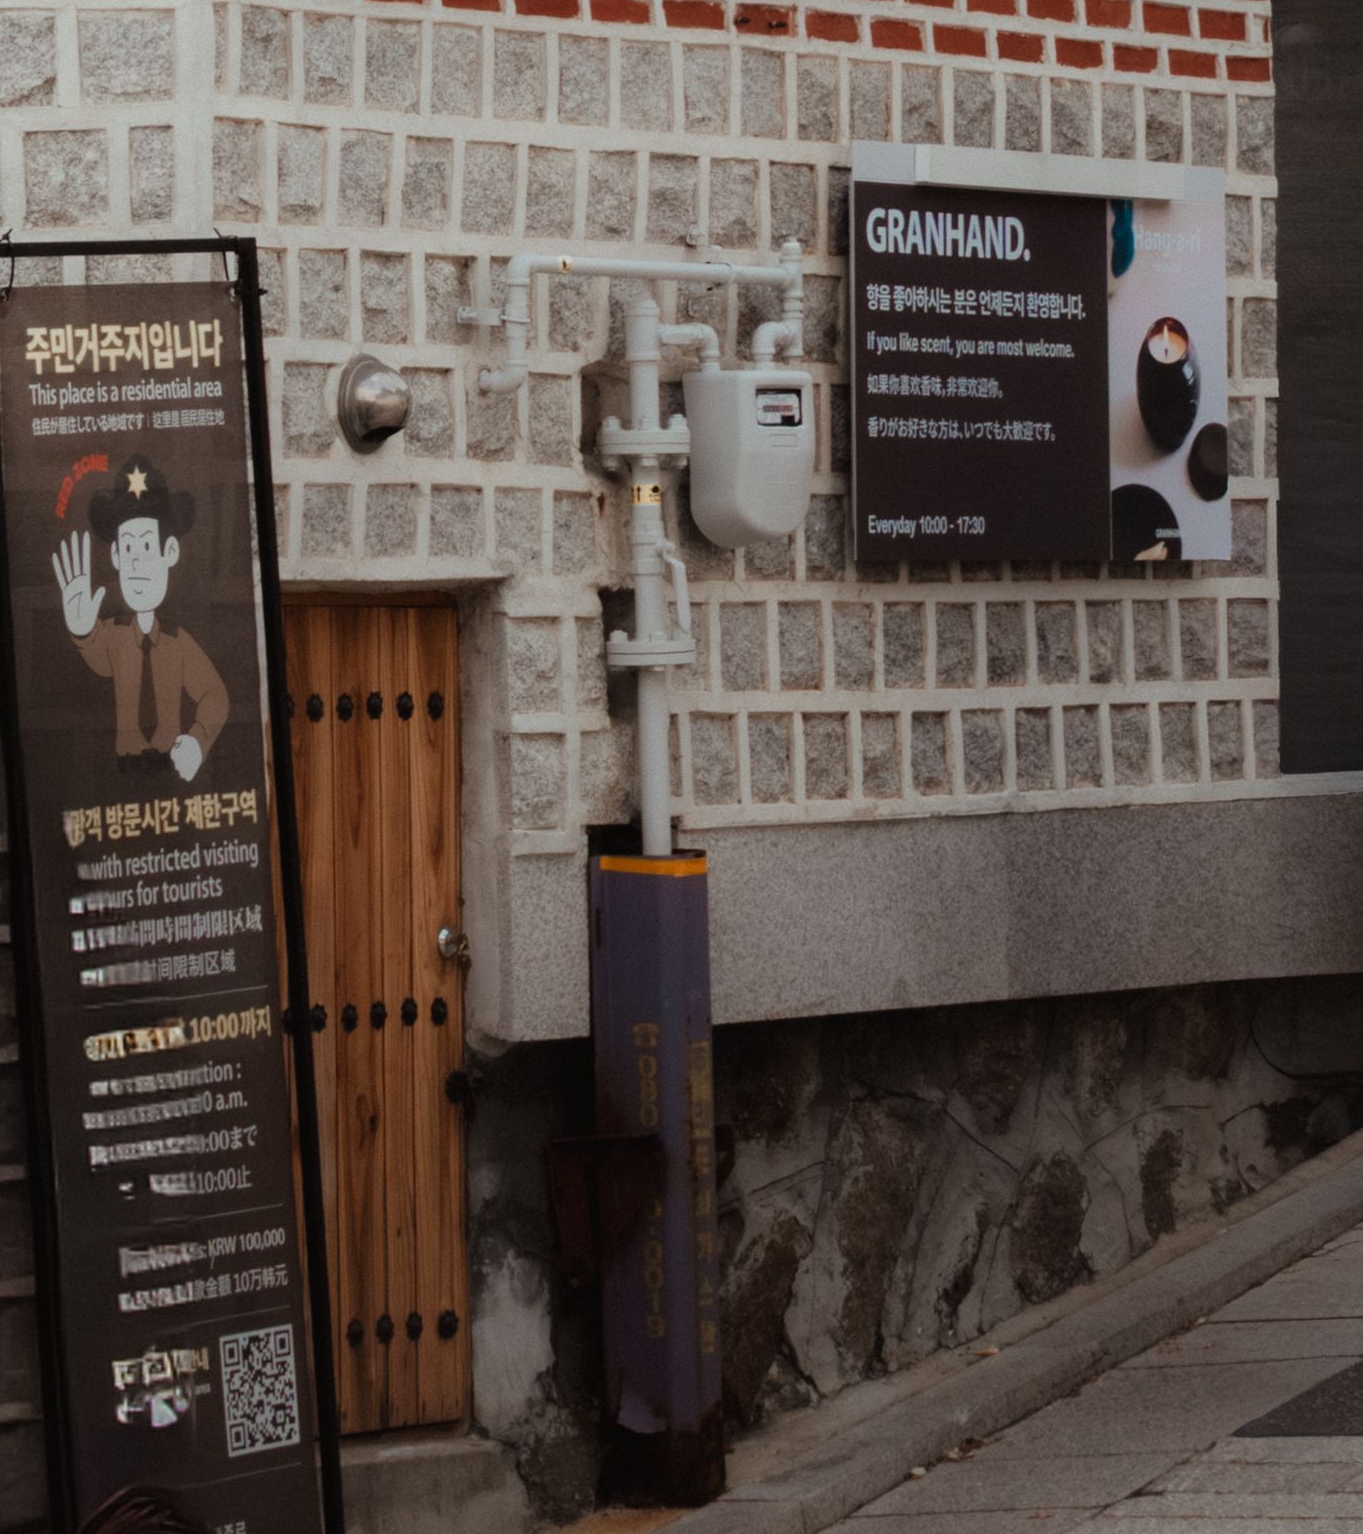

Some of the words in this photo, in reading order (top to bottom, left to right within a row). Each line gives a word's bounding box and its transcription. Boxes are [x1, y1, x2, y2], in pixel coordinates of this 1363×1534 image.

[866, 207, 1031, 262] GRANHAND.
[866, 283, 891, 311] 향을
[893, 285, 952, 314] 좋아하시는
[954, 288, 977, 315] 분은
[979, 290, 1025, 318] 언제든지
[1027, 291, 1086, 320] 환영합니다.
[25, 318, 224, 375] 주민거주지입니다
[867, 330, 876, 350] If
[876, 335, 897, 355] you
[899, 331, 918, 352] like
[920, 335, 954, 356] scent,
[955, 339, 975, 359] you
[977, 340, 995, 356] are
[996, 338, 1023, 357] most
[1025, 337, 1075, 358] welcome.
[28, 382, 56, 406] This
[59, 381, 95, 410] place
[97, 381, 108, 403] is
[110, 387, 119, 403] a
[121, 375, 191, 402] residential
[193, 380, 222, 398] area
[867, 514, 916, 539] Everyday
[918, 515, 948, 535] 10:00
[956, 515, 986, 535] 17:30
[105, 797, 181, 840] 방문시간
[184, 788, 258, 830] 제한구역
[90, 852, 123, 880] with
[125, 842, 200, 876] restricted
[203, 837, 259, 868] visiting
[136, 880, 159, 907] for
[162, 875, 223, 902] tourists
[189, 1004, 272, 1045] 10:00까지
[215, 1089, 249, 1111] a.m.
[207, 1236, 237, 1258] KRW
[239, 1226, 286, 1253] 100,000
